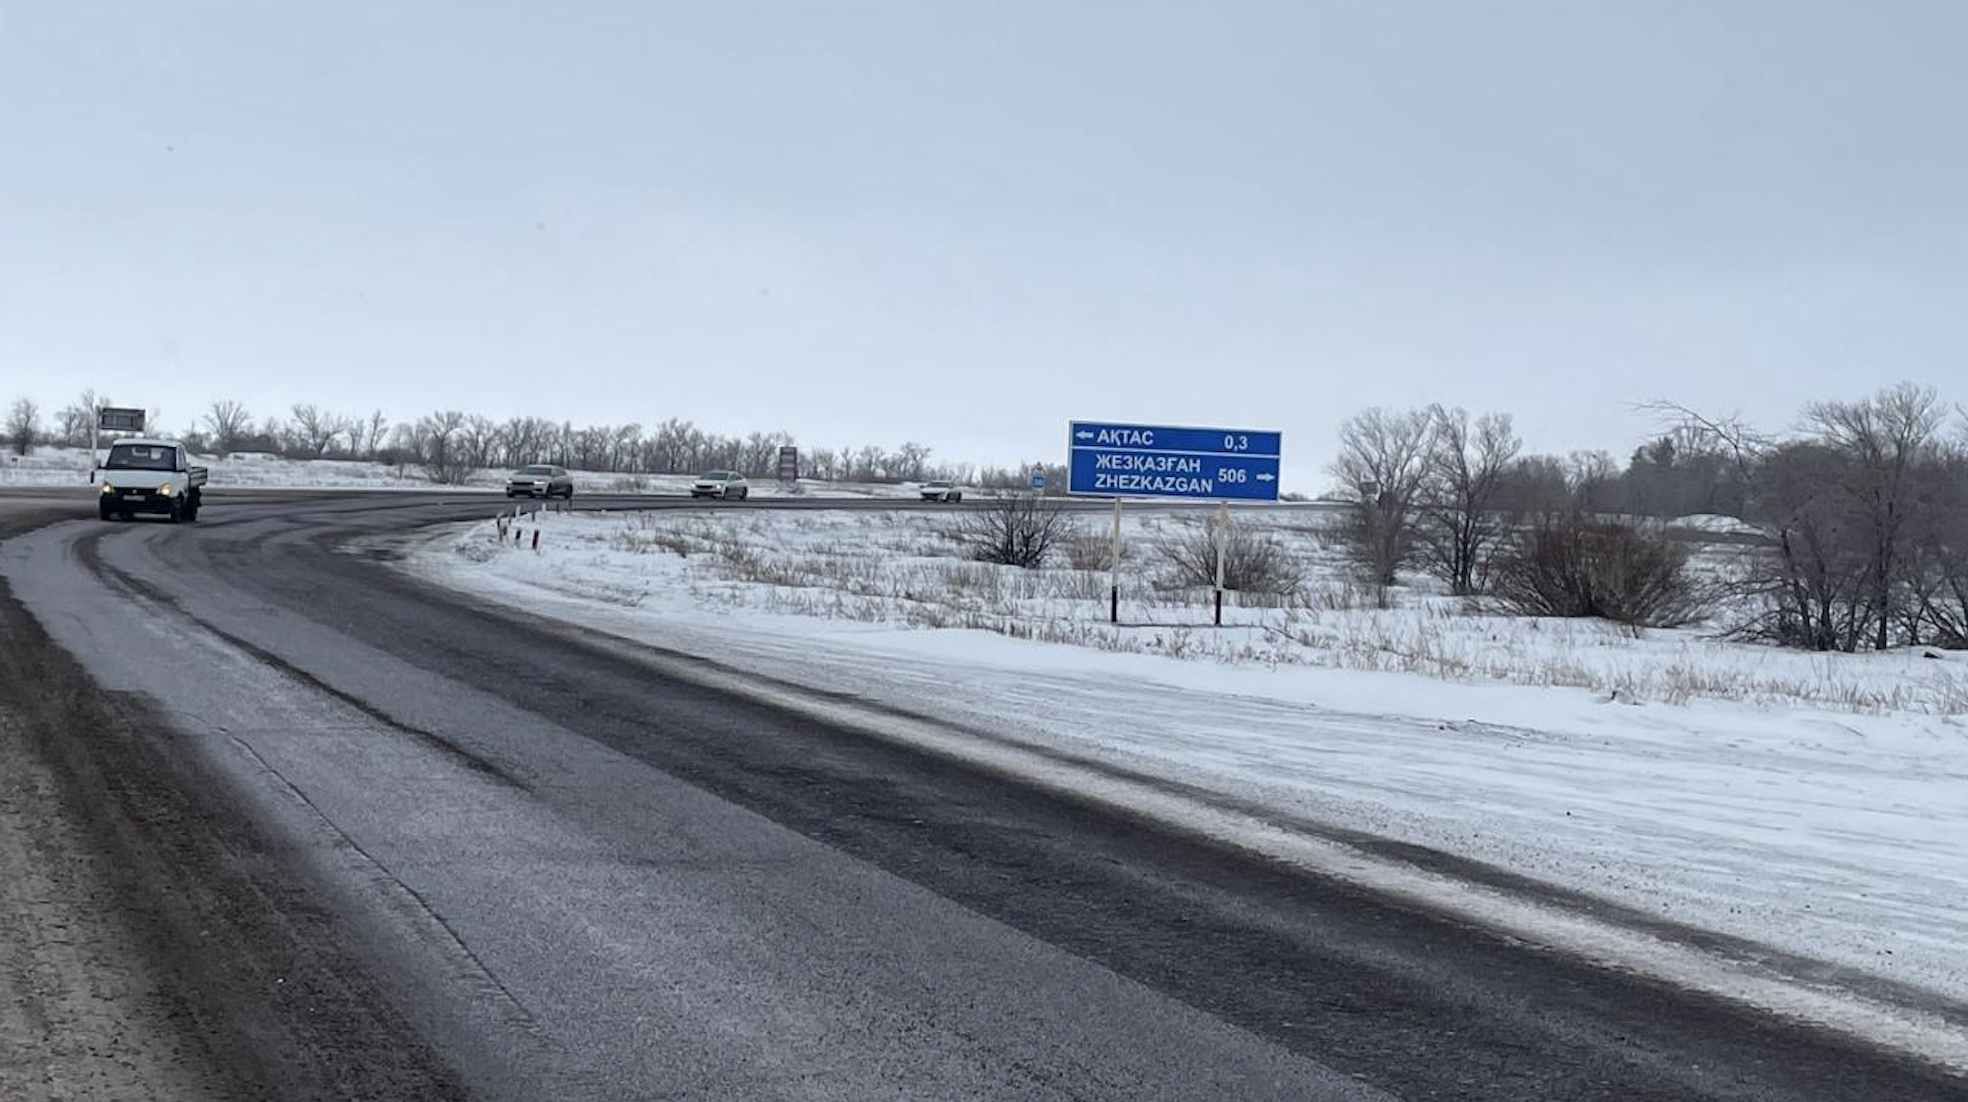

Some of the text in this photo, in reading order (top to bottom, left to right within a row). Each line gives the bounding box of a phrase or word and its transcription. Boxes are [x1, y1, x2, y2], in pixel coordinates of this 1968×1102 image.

[1097, 429, 1248, 452] АҚТАС 0,3
[1095, 454, 1201, 473] ЖЕЗҚАЗҒАН
[1094, 474, 1213, 493] ZHEZKAZGAN
[1218, 468, 1247, 483] 506
